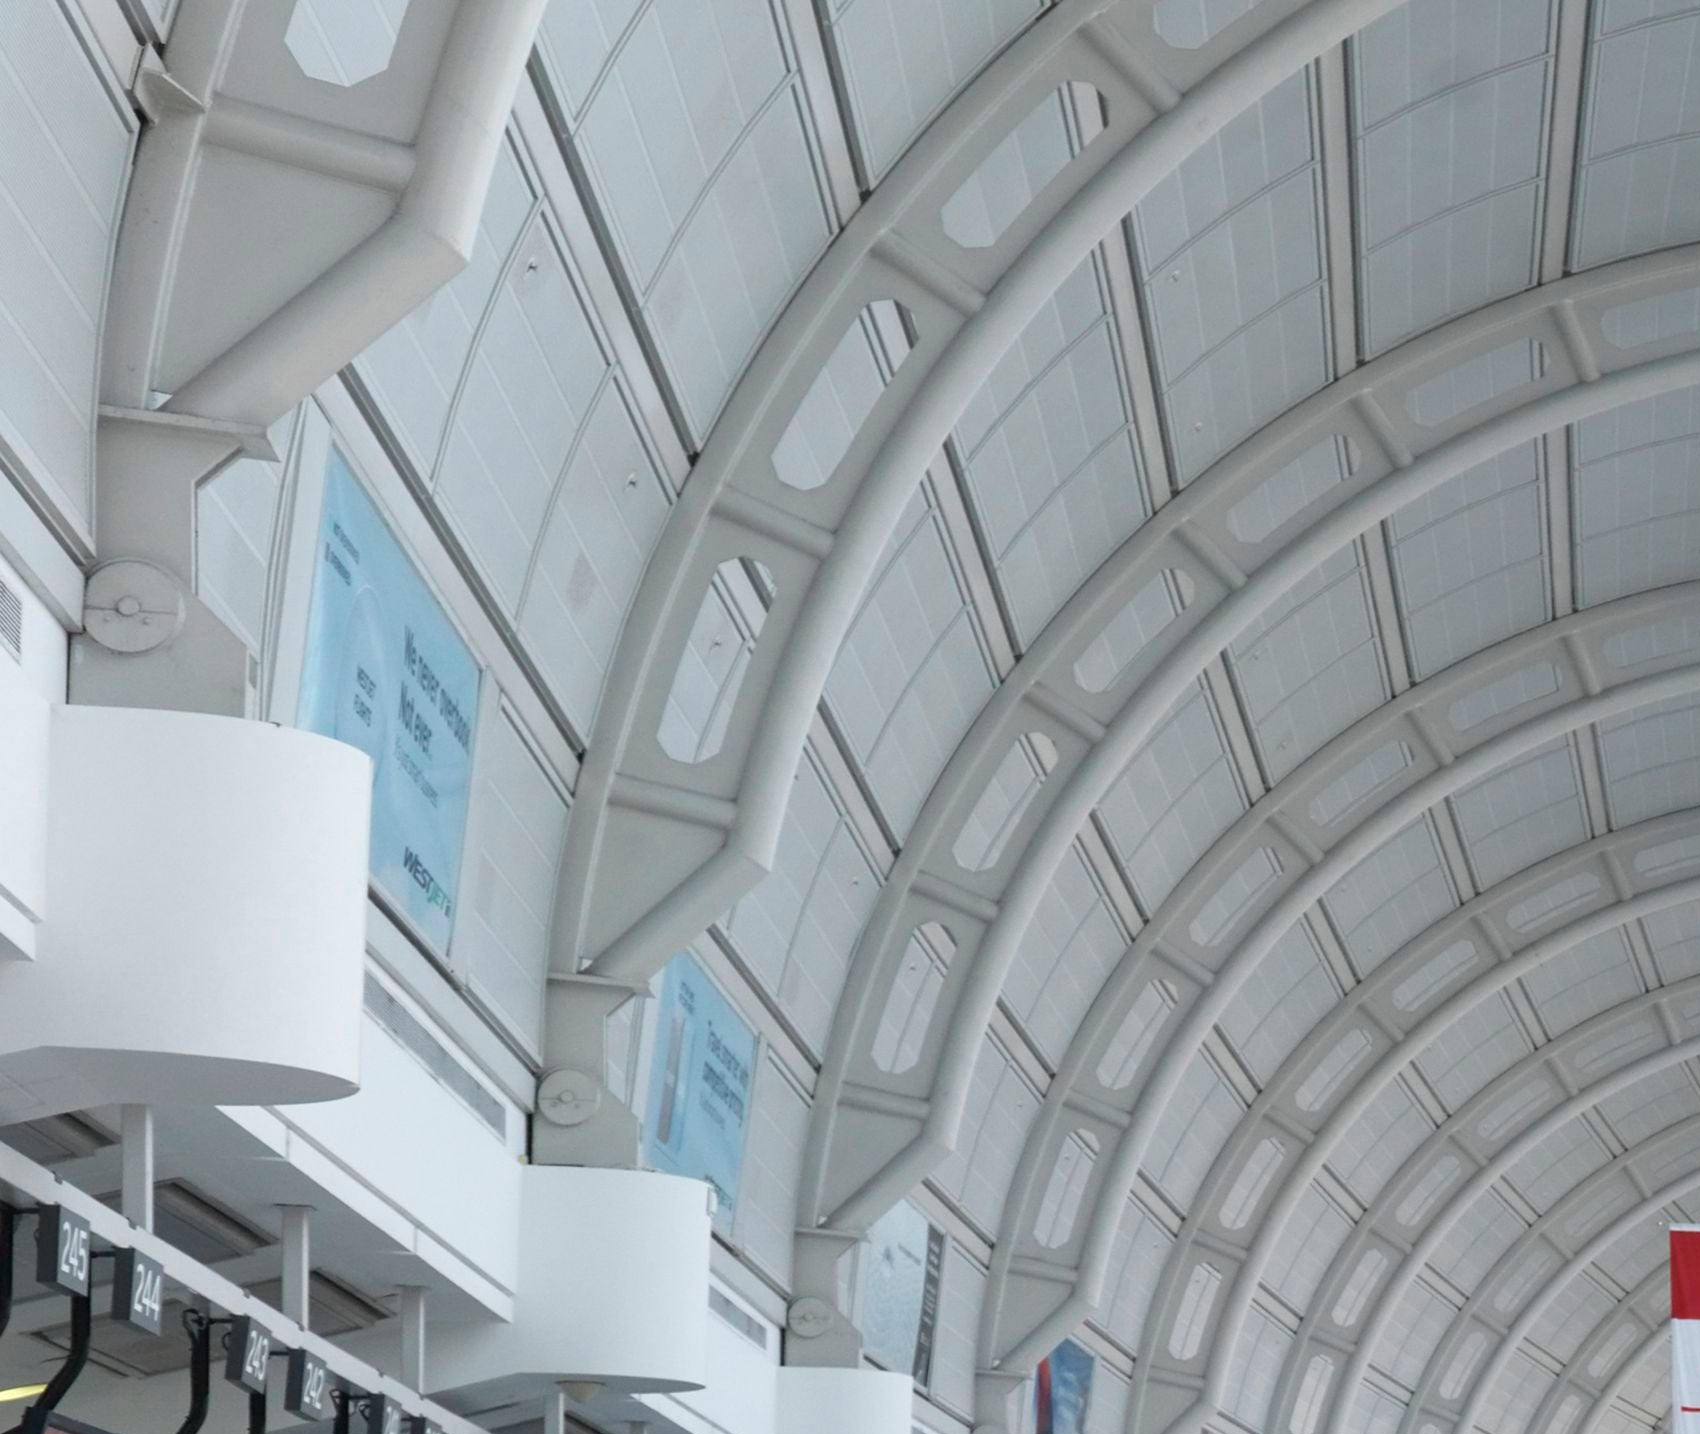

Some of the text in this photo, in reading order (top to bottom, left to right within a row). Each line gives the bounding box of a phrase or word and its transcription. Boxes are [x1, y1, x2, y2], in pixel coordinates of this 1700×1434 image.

[403, 846, 447, 909] WESTJET
[61, 1221, 88, 1280] 245
[134, 1263, 161, 1321] 244
[245, 1330, 268, 1381] 243
[303, 1362, 324, 1410] 242
